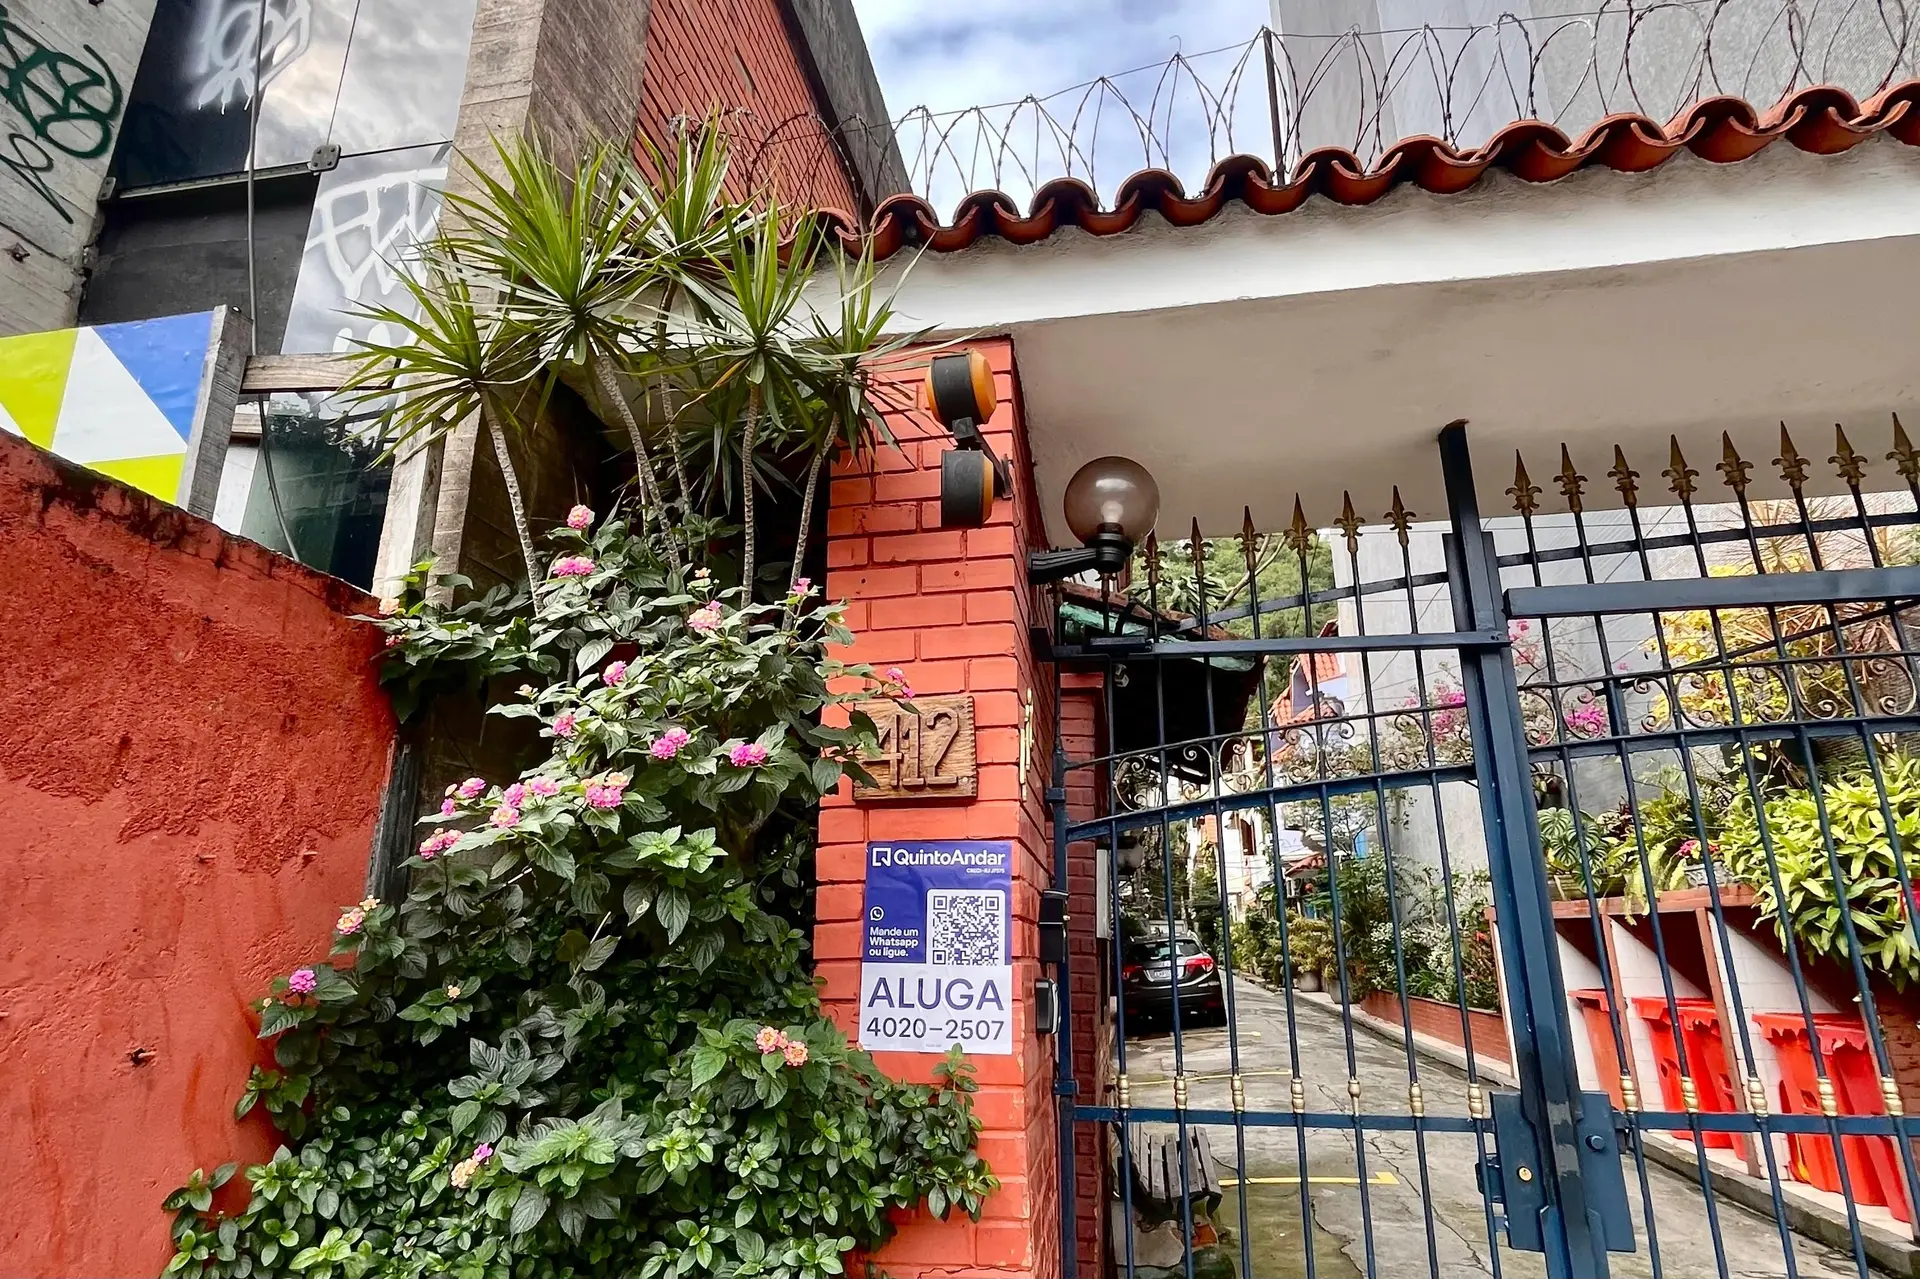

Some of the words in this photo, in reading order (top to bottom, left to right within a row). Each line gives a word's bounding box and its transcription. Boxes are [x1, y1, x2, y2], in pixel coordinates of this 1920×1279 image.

[861, 707, 959, 788] 412
[893, 849, 1006, 866] QuintoAndar
[869, 926, 902, 937] Mande
[903, 929, 919, 937] um
[869, 936, 919, 949] Whatsapp
[868, 948, 882, 956] ou
[882, 946, 909, 959] ligue.
[867, 977, 1004, 1010] ALUGA
[866, 1017, 1005, 1041] 4020-2507
